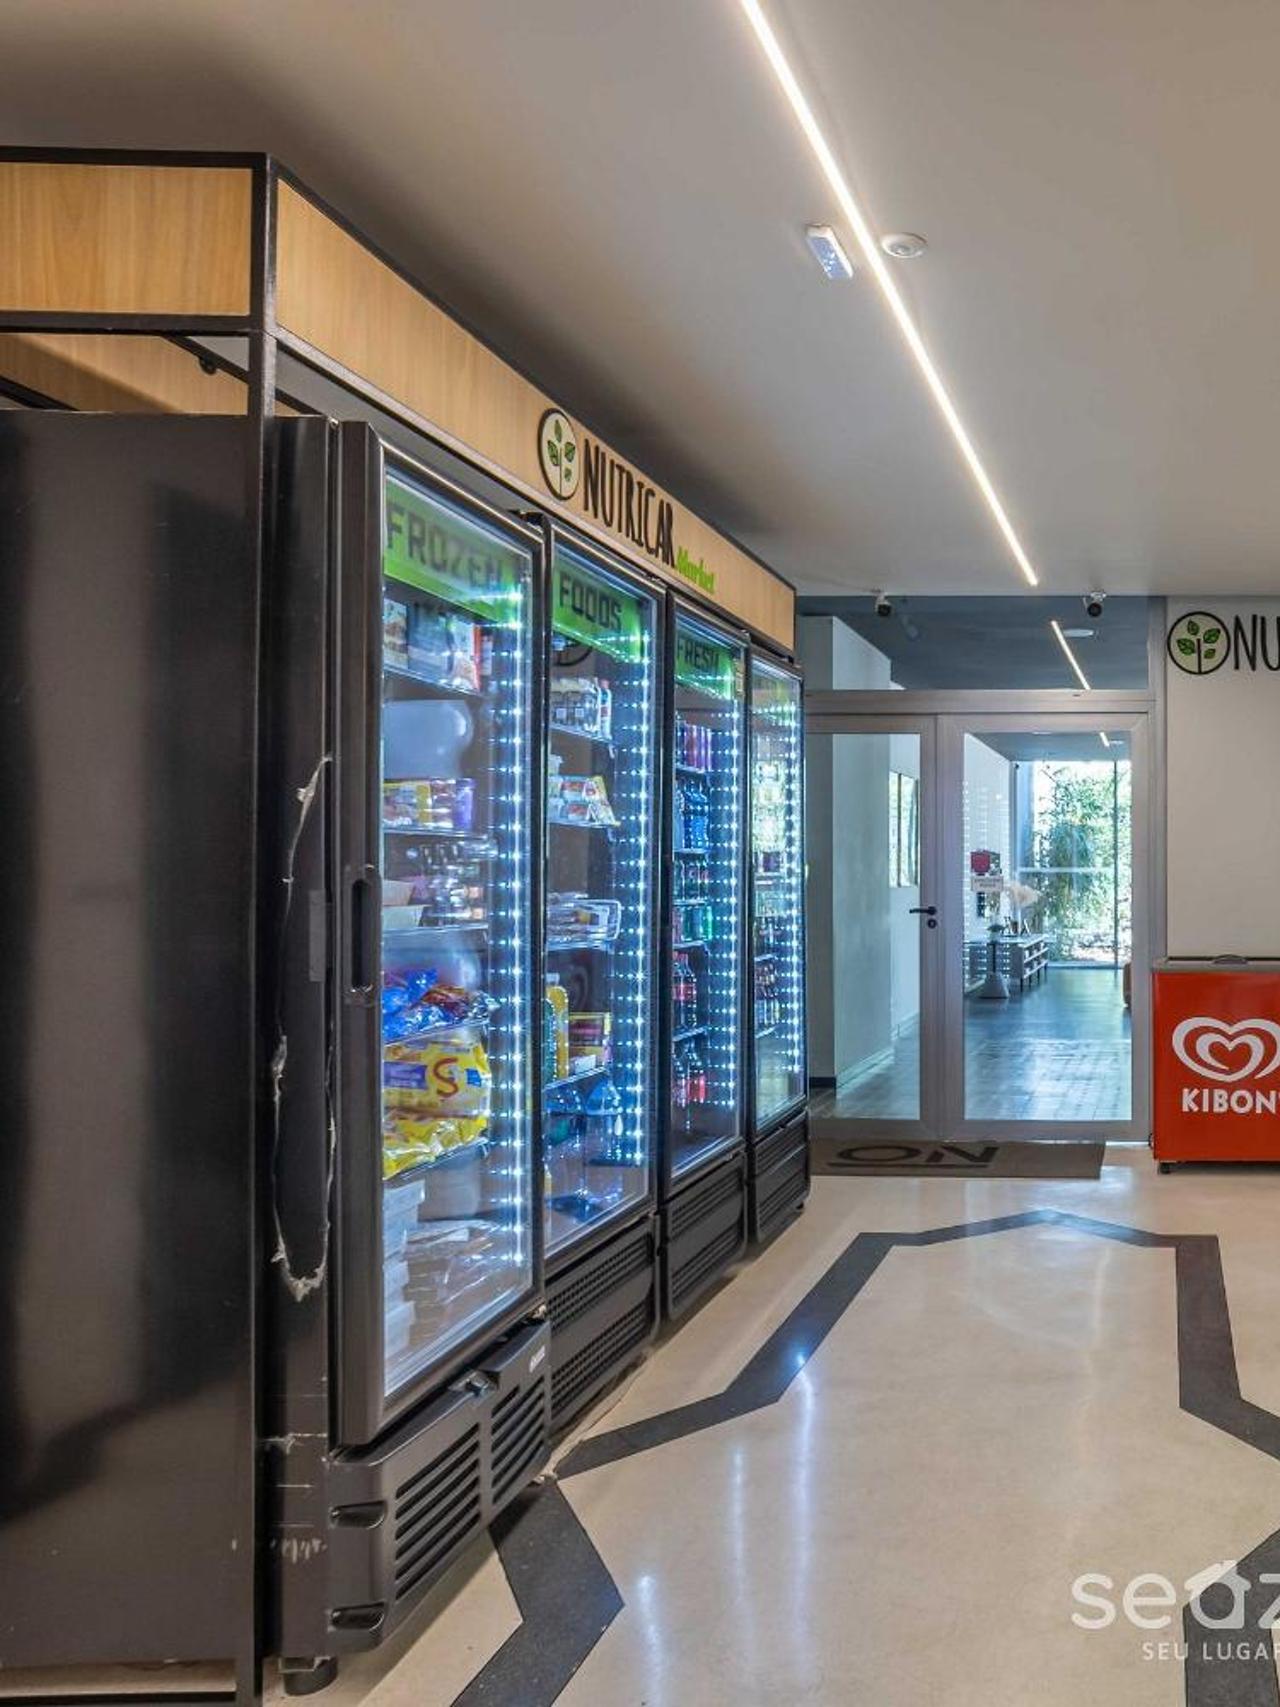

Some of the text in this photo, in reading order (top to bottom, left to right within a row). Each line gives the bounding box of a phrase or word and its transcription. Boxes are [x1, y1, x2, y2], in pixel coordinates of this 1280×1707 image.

[584, 438, 675, 569] NUTRICAR
[386, 501, 508, 588] FROZEN
[559, 571, 623, 632] FOODS
[677, 637, 719, 671] FRESH
[1181, 1087, 1278, 1115] KIBON
